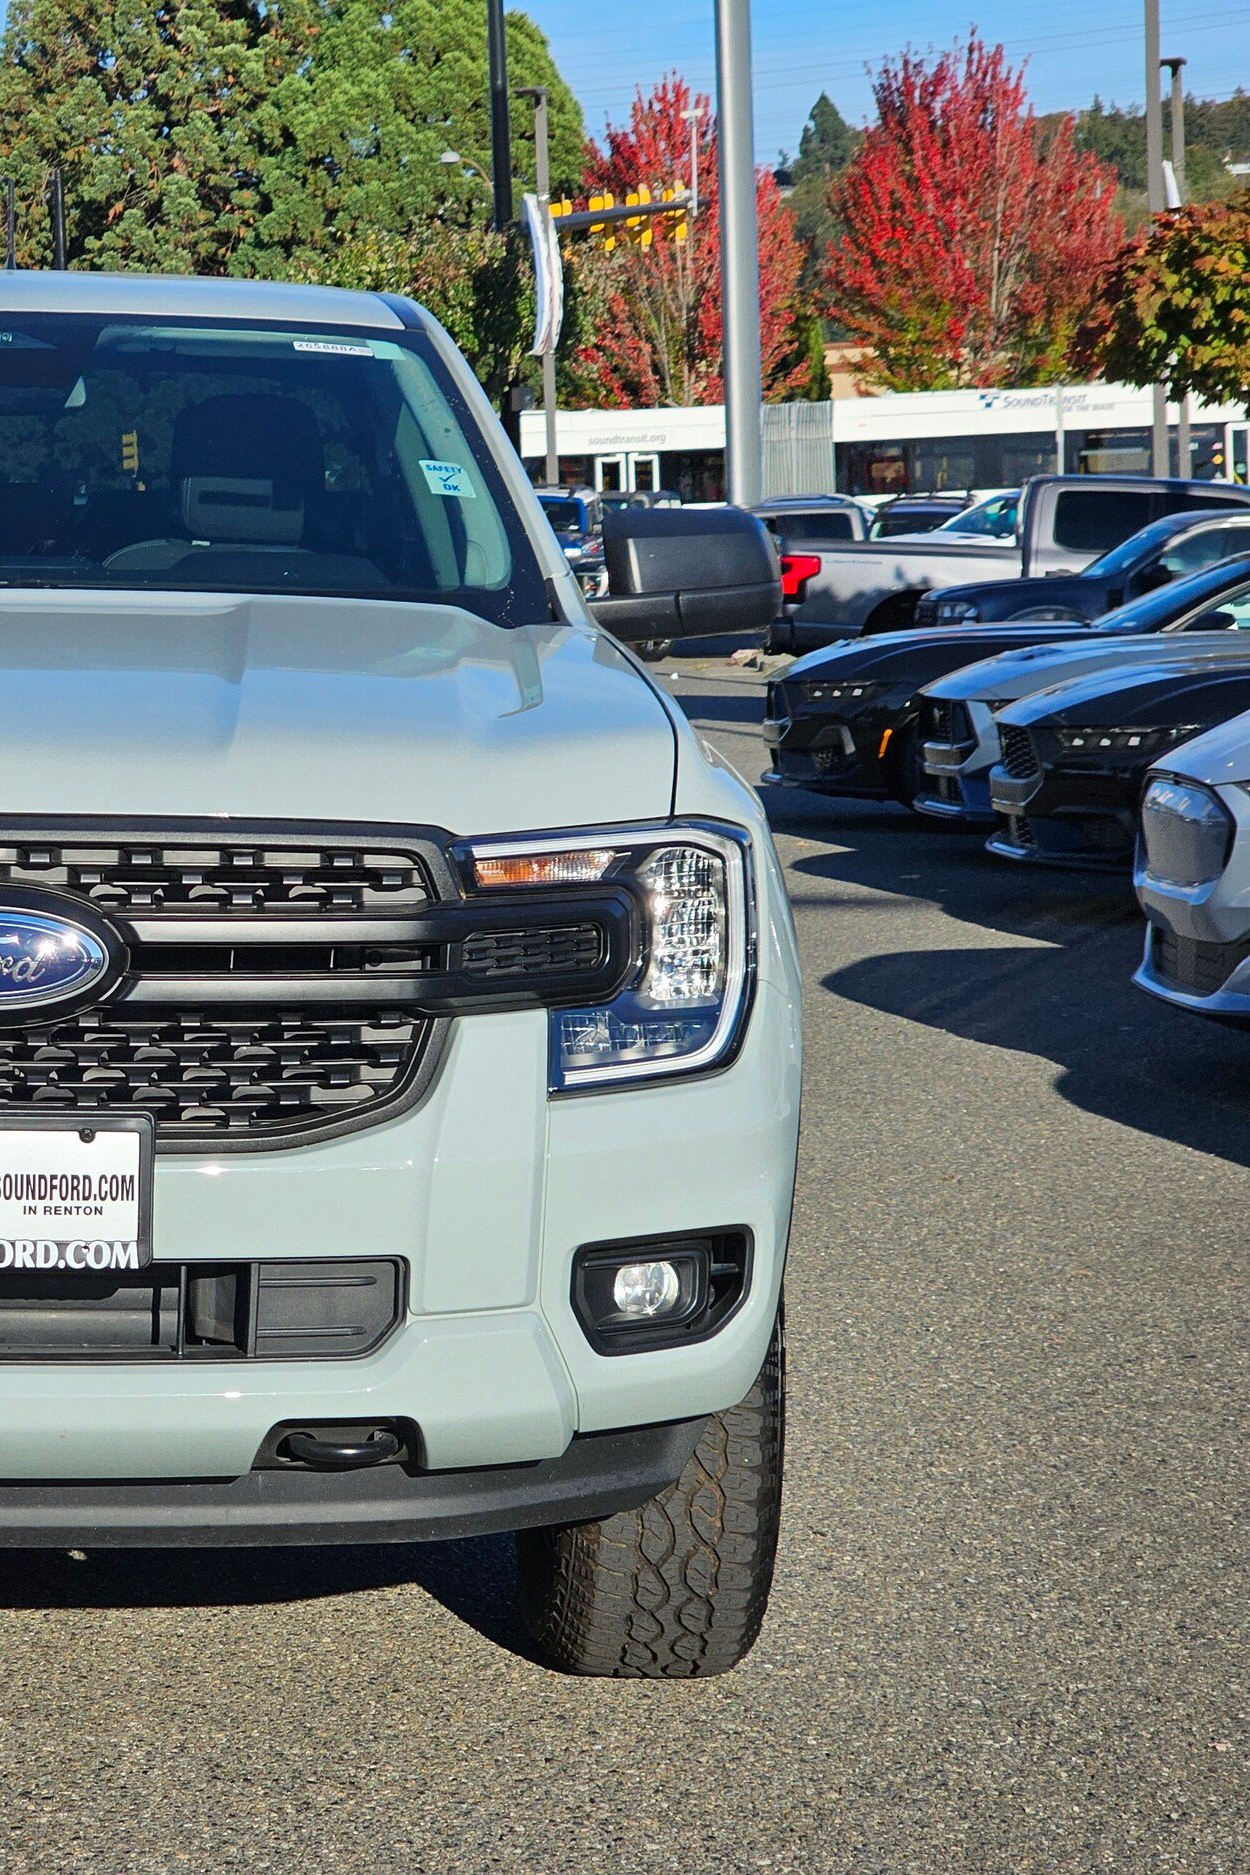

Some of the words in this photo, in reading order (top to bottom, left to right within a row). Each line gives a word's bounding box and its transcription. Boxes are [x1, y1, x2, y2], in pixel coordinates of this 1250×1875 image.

[588, 433, 667, 445] soundtransit.org
[426, 464, 462, 474] SAFETY
[443, 483, 461, 491] OK
[23, 1205, 37, 1215] IN
[43, 1205, 104, 1216] RENTON
